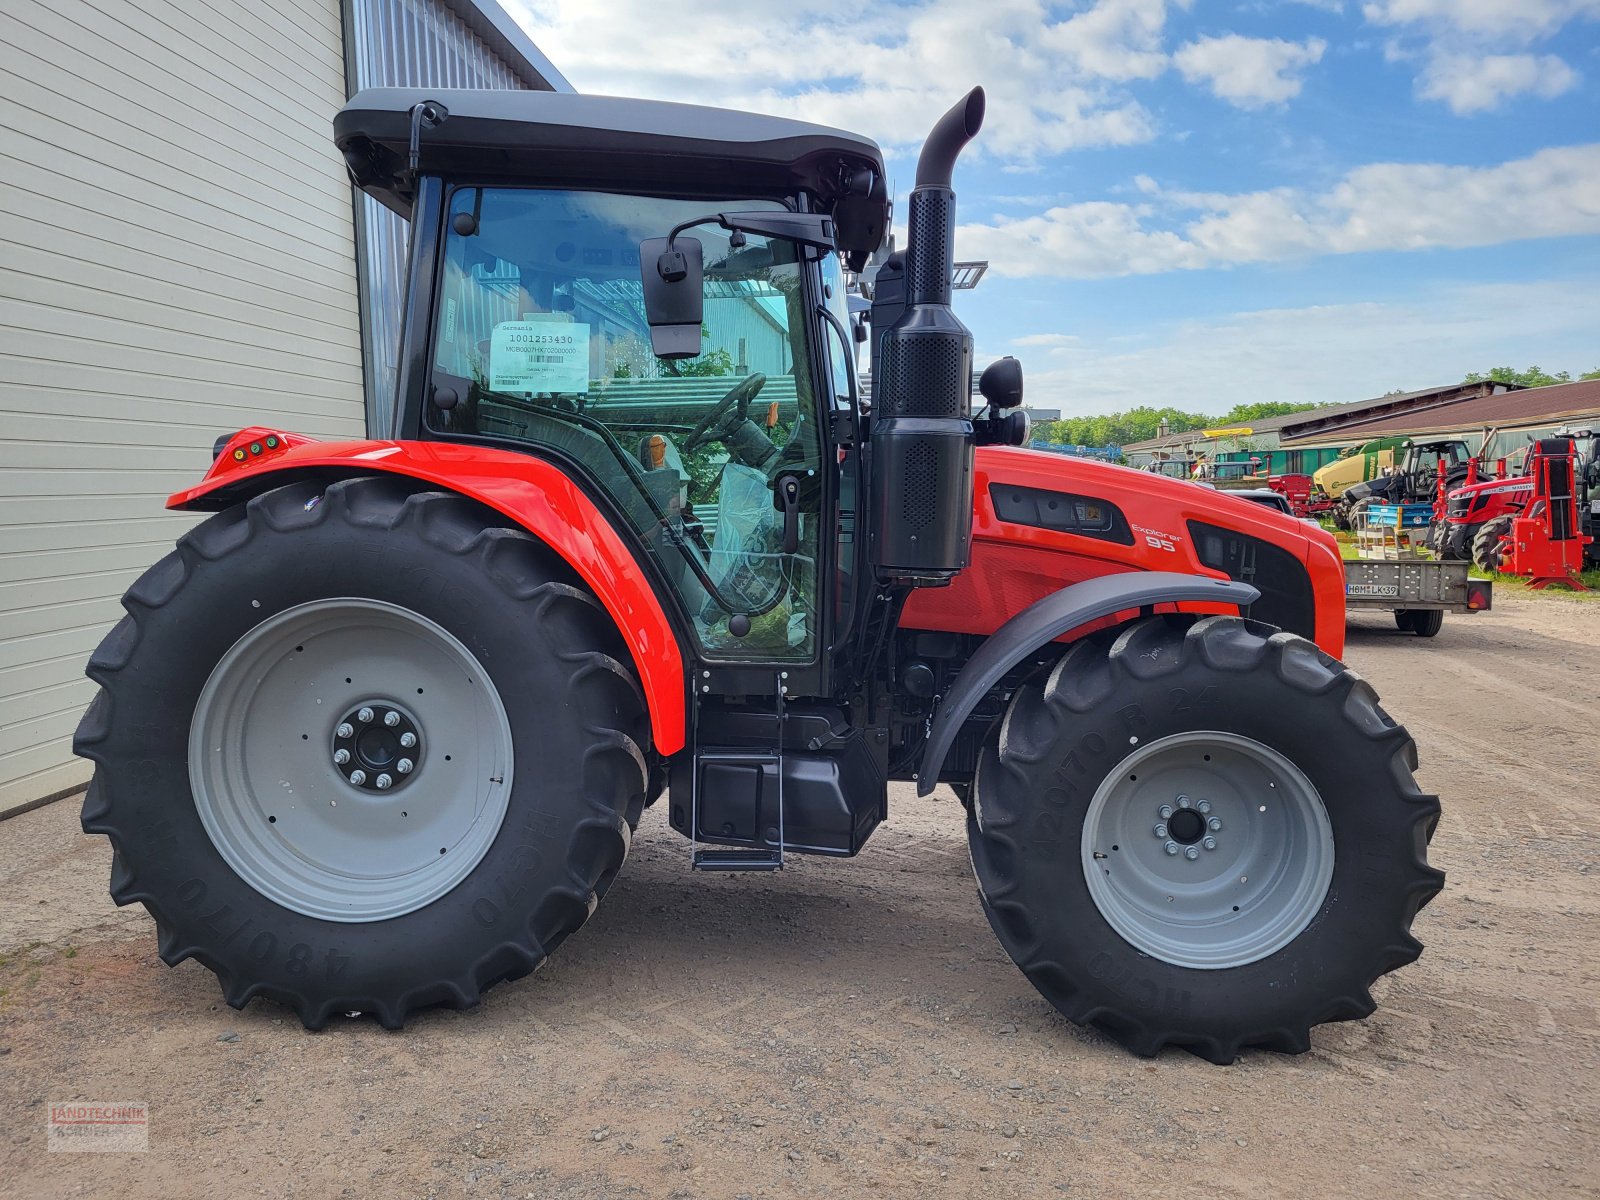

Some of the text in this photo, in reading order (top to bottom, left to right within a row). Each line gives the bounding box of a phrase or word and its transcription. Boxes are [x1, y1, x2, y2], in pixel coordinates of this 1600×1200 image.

[509, 334, 573, 344] 1001253430
[1131, 523, 1183, 542] Explorer
[1145, 536, 1176, 552] 95
